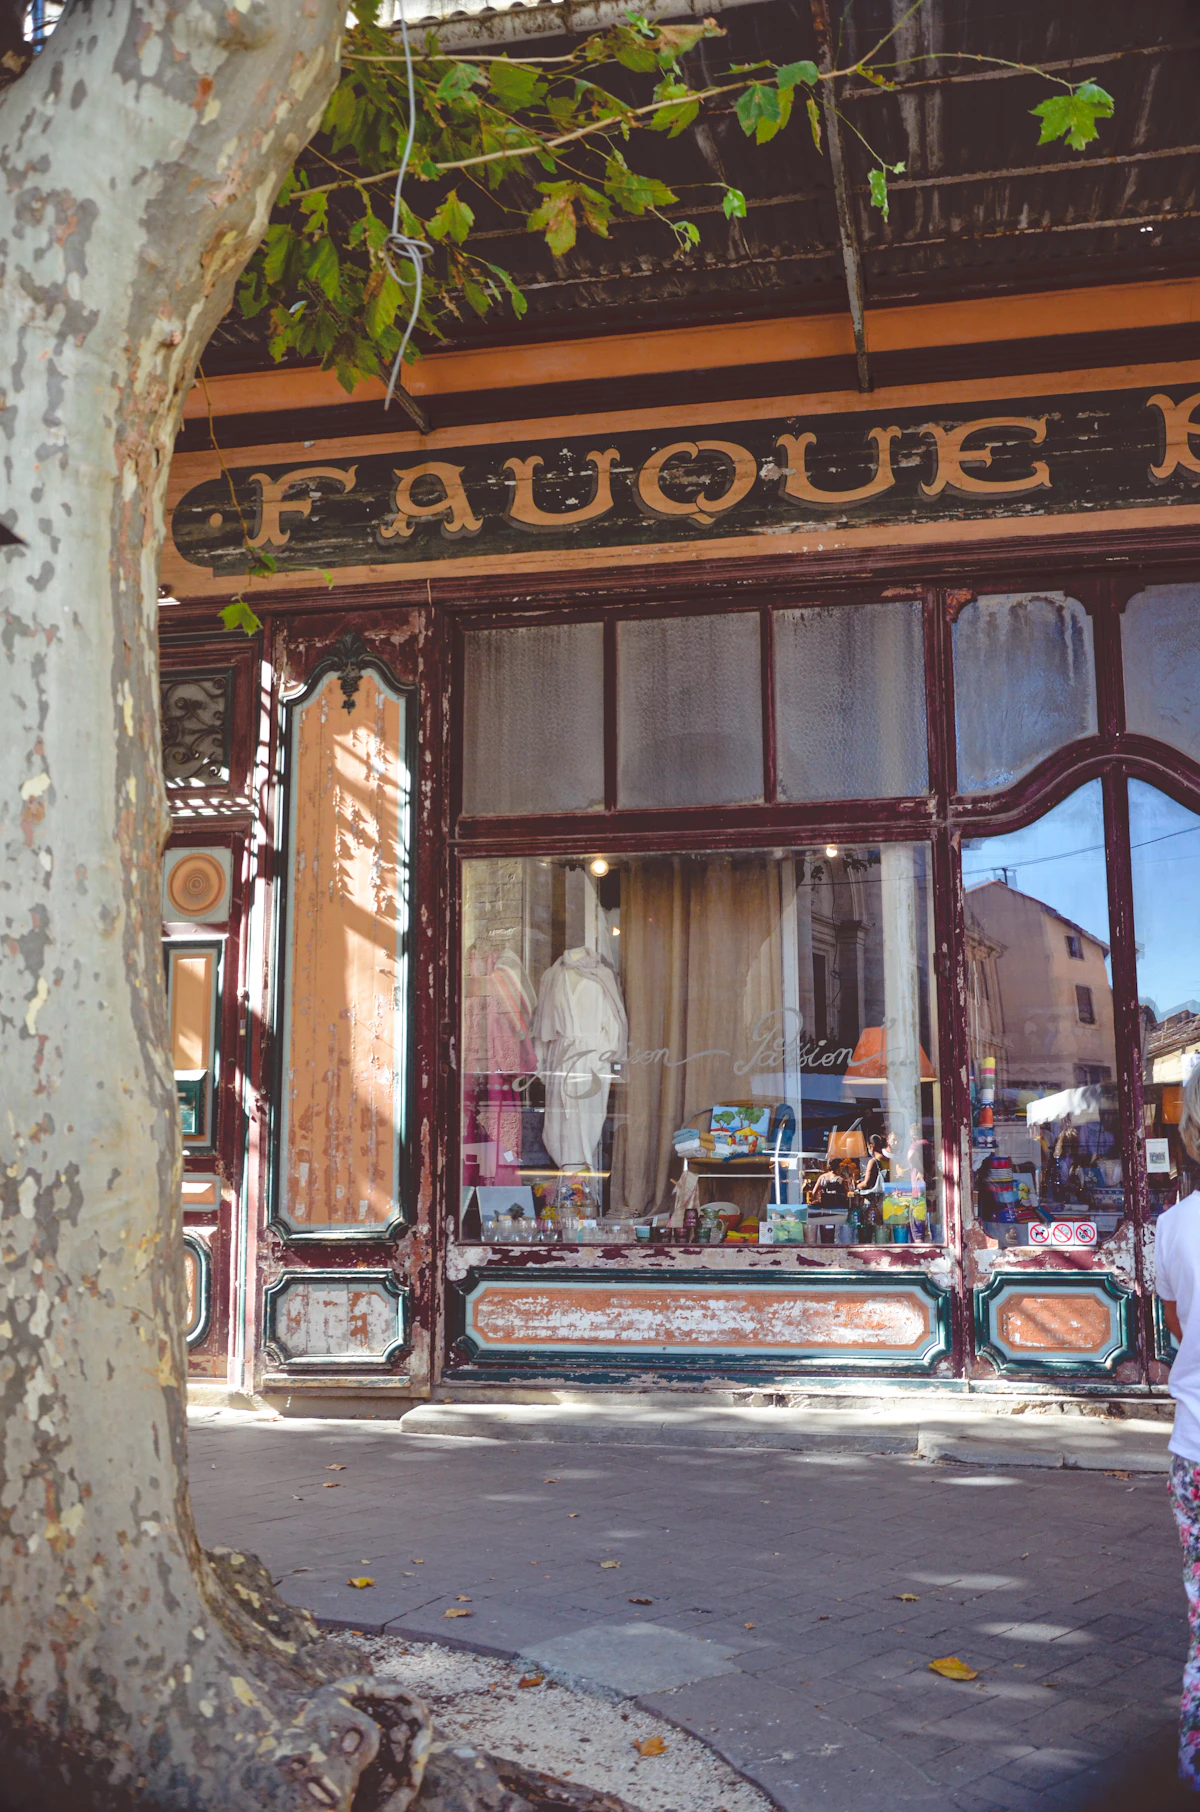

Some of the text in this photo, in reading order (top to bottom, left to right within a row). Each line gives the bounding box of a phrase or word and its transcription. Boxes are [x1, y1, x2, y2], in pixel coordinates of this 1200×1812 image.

[247, 416, 1053, 548] FAUQUE
[512, 1006, 903, 1100] Maison Passion
